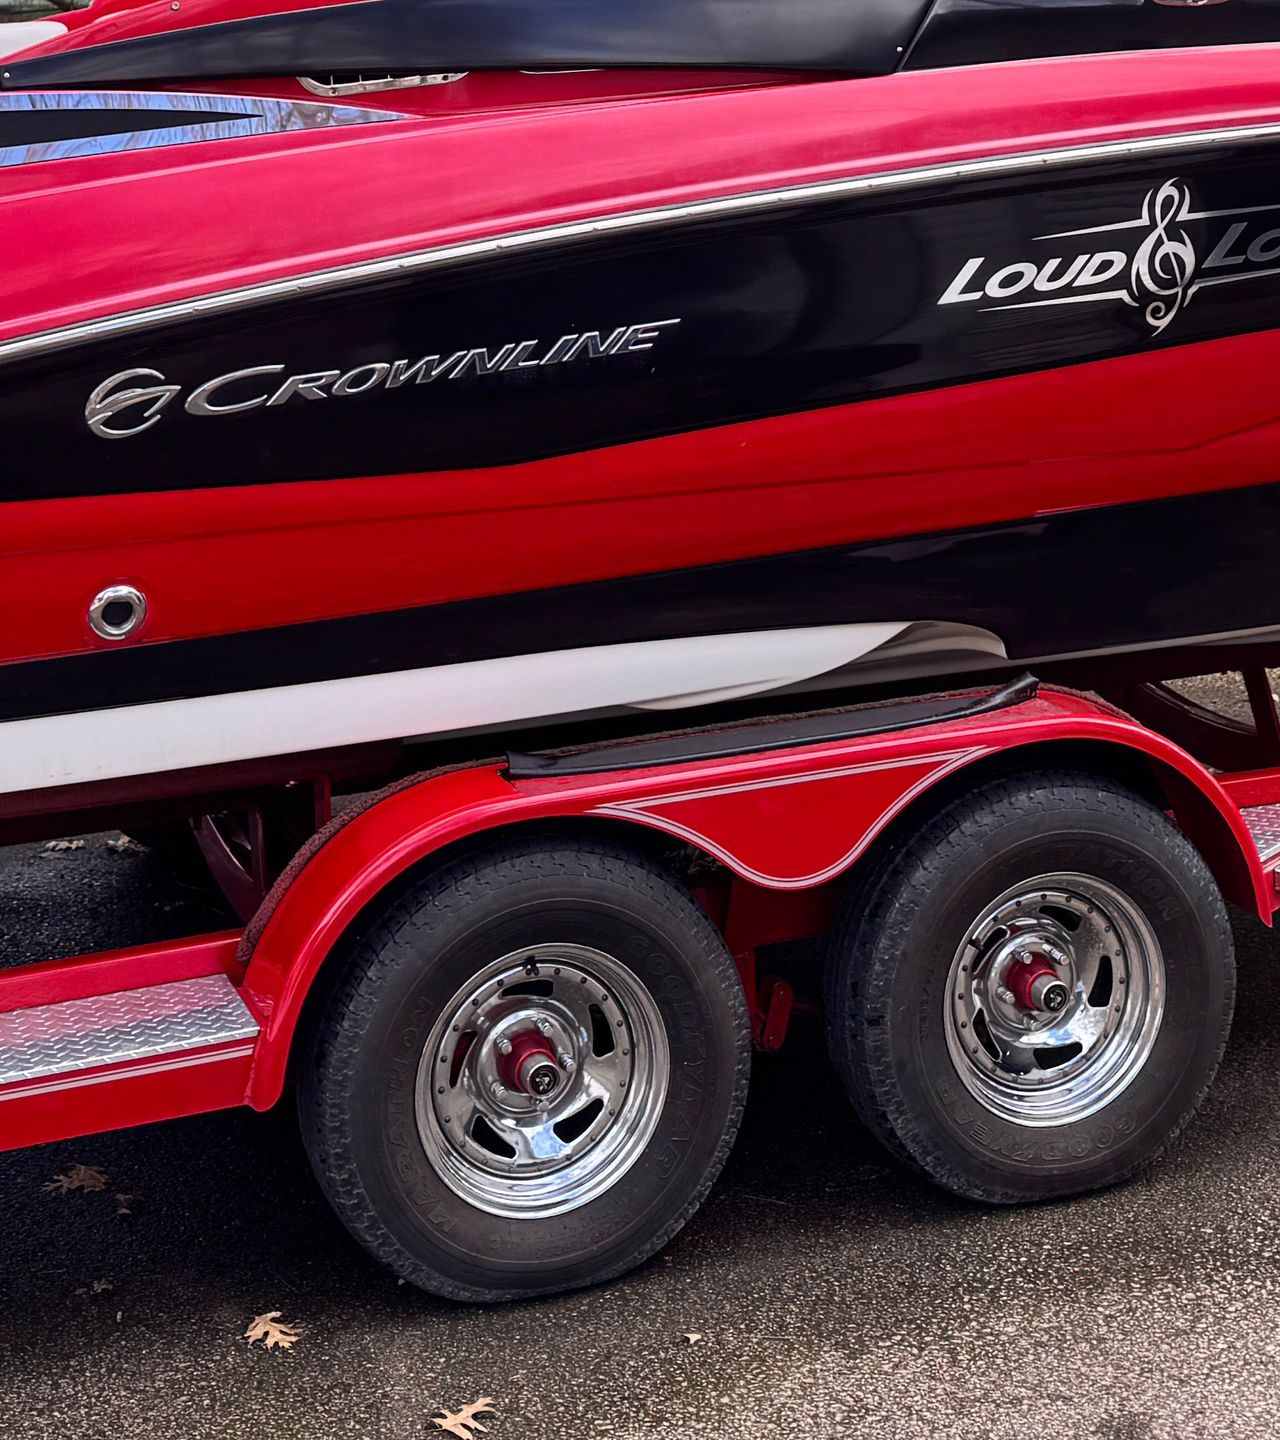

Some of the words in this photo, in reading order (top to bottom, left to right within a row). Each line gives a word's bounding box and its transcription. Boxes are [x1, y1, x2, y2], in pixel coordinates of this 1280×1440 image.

[937, 251, 1127, 305] LOUD
[184, 318, 681, 417] CROWNLINE
[936, 1078, 1138, 1162] GOODYEAR
